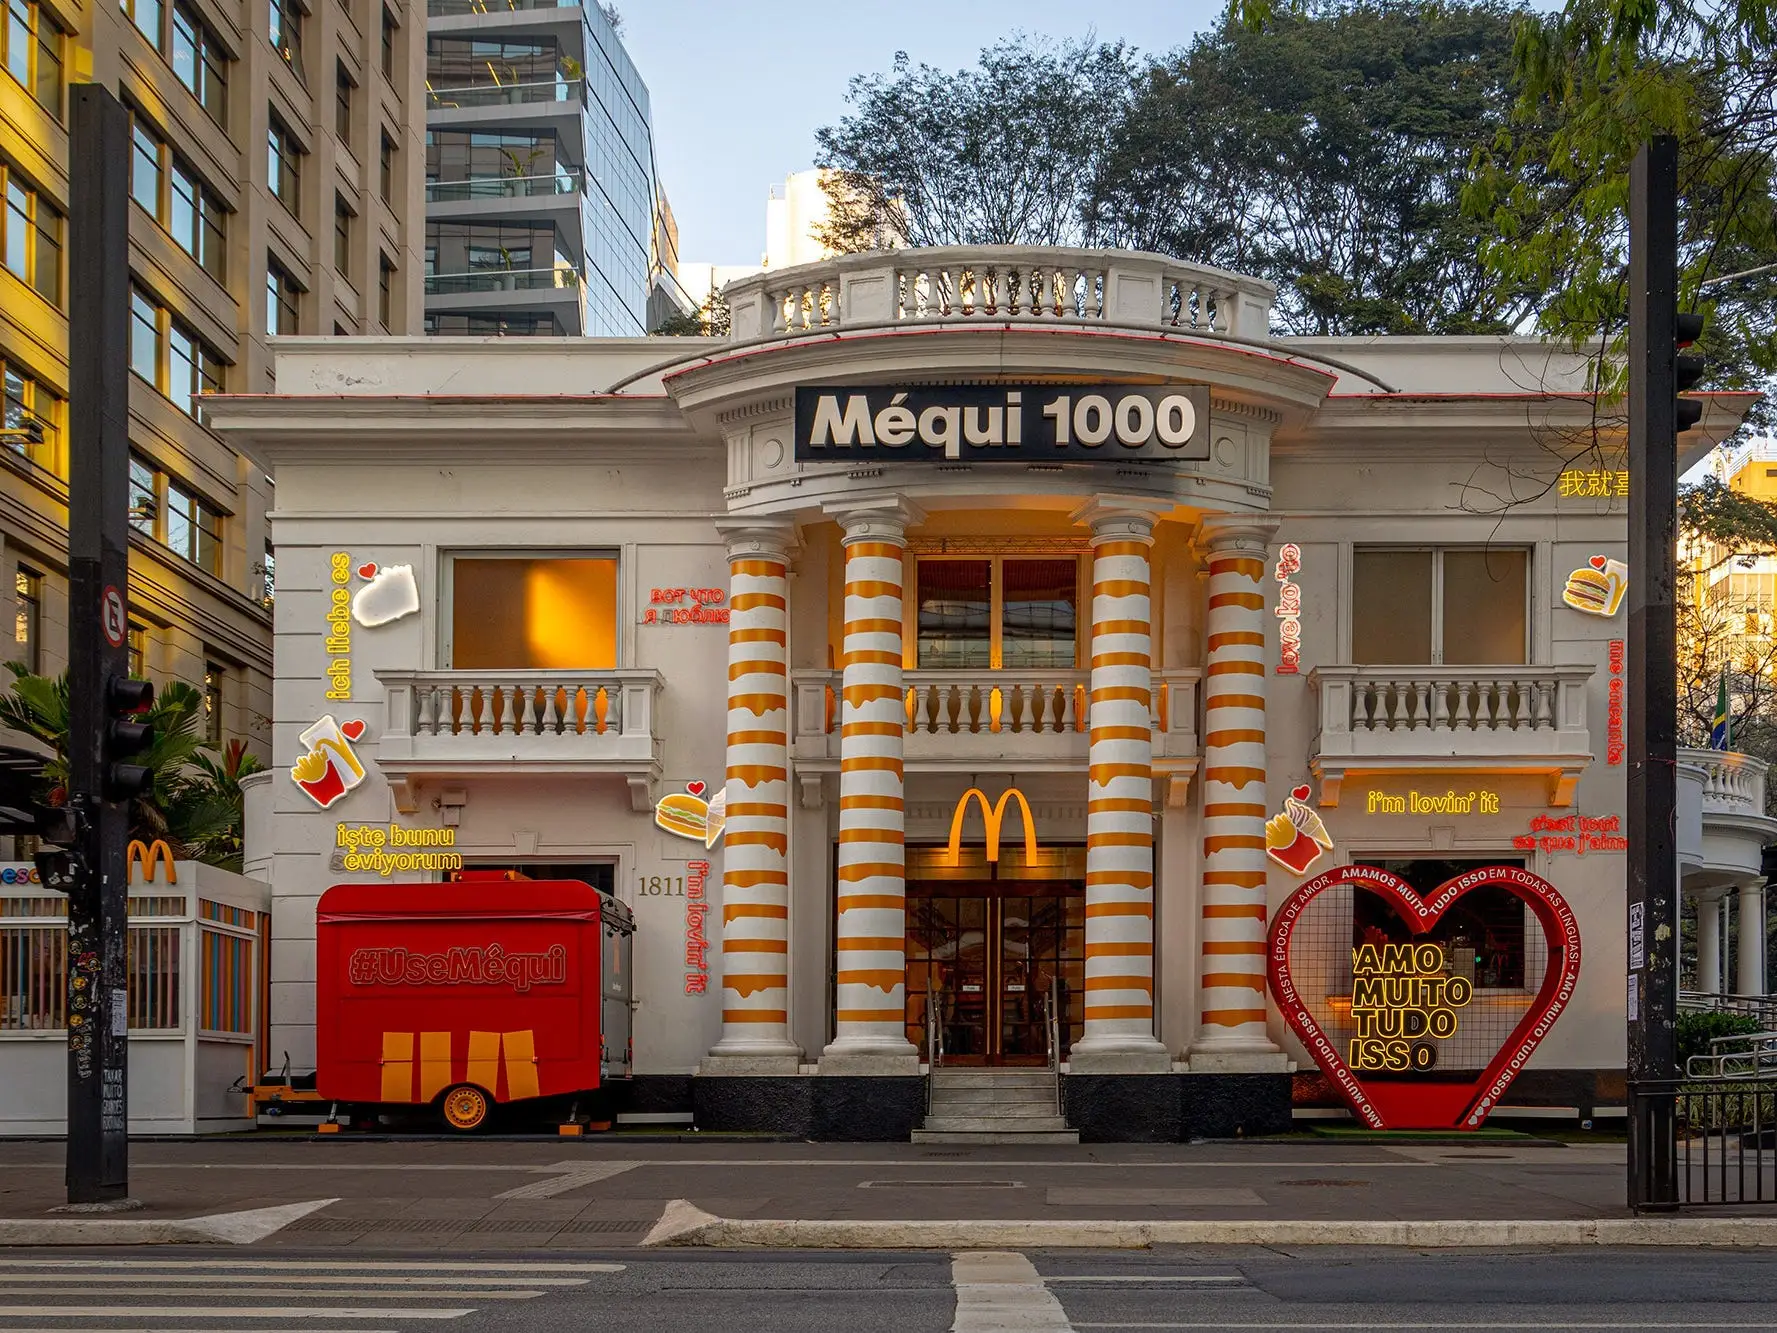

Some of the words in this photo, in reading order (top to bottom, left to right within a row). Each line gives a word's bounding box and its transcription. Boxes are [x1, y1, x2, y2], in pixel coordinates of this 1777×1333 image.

[809, 391, 1021, 459] Méqui
[1043, 394, 1196, 448] 1000
[331, 552, 350, 584] es
[1276, 583, 1299, 617] ko
[326, 588, 350, 653] liebe
[1276, 620, 1299, 675] love
[1608, 640, 1624, 675] me
[326, 659, 350, 699] ich
[1607, 678, 1625, 765] encanta
[1480, 791, 1499, 813] it
[337, 823, 386, 853] işte
[390, 824, 455, 847] bunu
[1578, 815, 1621, 832] tout
[1540, 836, 1575, 853] que
[1577, 833, 1628, 854] j'aim
[638, 876, 685, 896] 1811
[1341, 868, 1396, 887] AMAMOS
[1457, 870, 1487, 890] ISSO
[1489, 868, 1506, 879] EM
[1510, 869, 1548, 894] TODAS
[1286, 902, 1301, 919] DE
[1396, 884, 1428, 917] MUITO
[1428, 886, 1458, 916] TUDO
[1546, 891, 1561, 907] AS
[1273, 920, 1291, 961] ÉPOCA
[351, 944, 566, 991] #UseMéqui
[1353, 944, 1443, 974] AMO
[685, 973, 709, 994] it
[1278, 964, 1297, 1003] NESTA
[1352, 977, 1472, 1007] MUITO
[1559, 972, 1576, 1001] AMO
[1297, 1011, 1319, 1038] ISSO
[1351, 1008, 1457, 1038] TUDO
[1534, 1001, 1563, 1038] MUITO
[1315, 1038, 1339, 1069] TUDO
[1349, 1039, 1438, 1072] ISSO
[1510, 1039, 1537, 1069] TUDO
[1336, 1068, 1365, 1104] MUITO
[1488, 1070, 1514, 1100] ISSO!
[1362, 1104, 1383, 1129] AMO
